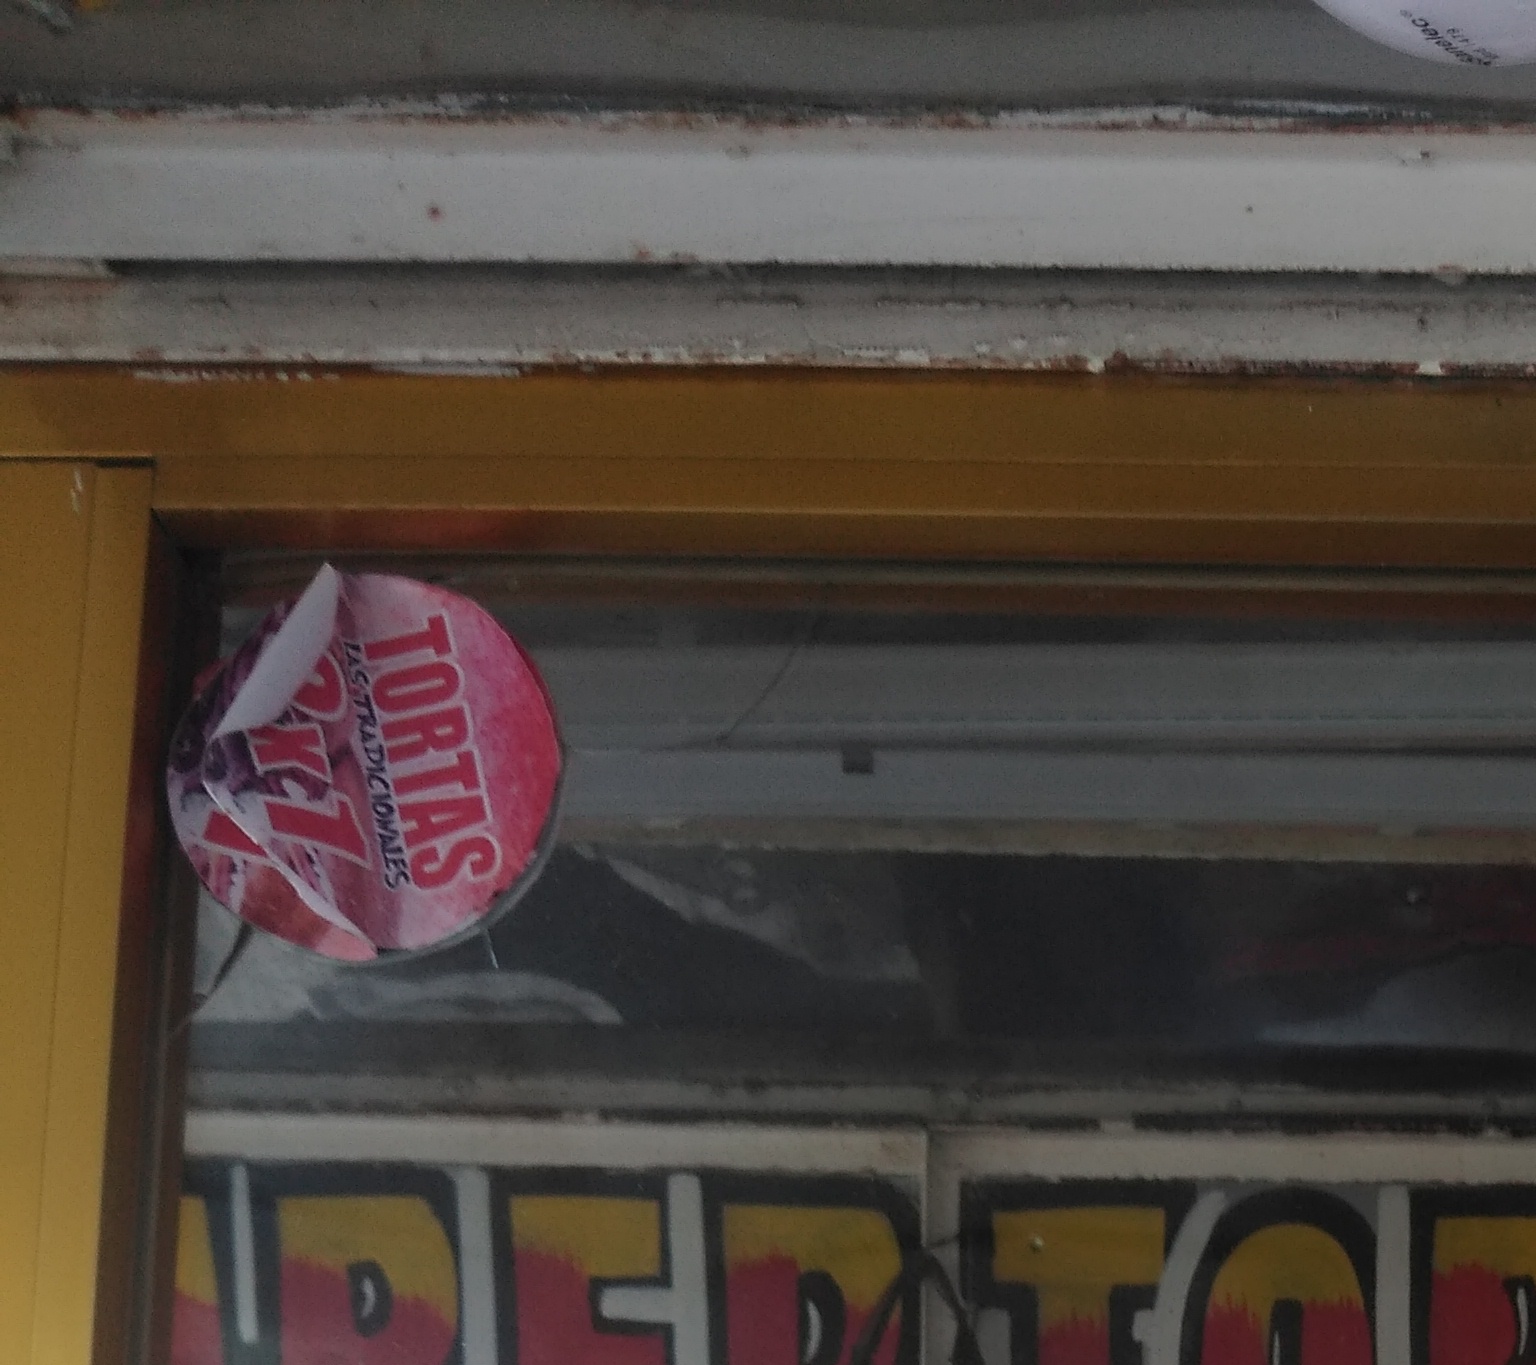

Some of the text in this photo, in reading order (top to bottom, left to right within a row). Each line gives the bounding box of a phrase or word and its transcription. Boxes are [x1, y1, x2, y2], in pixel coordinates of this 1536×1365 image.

[343, 641, 411, 891] LAS TRADICIONALES
[361, 611, 498, 891] TORTAS
